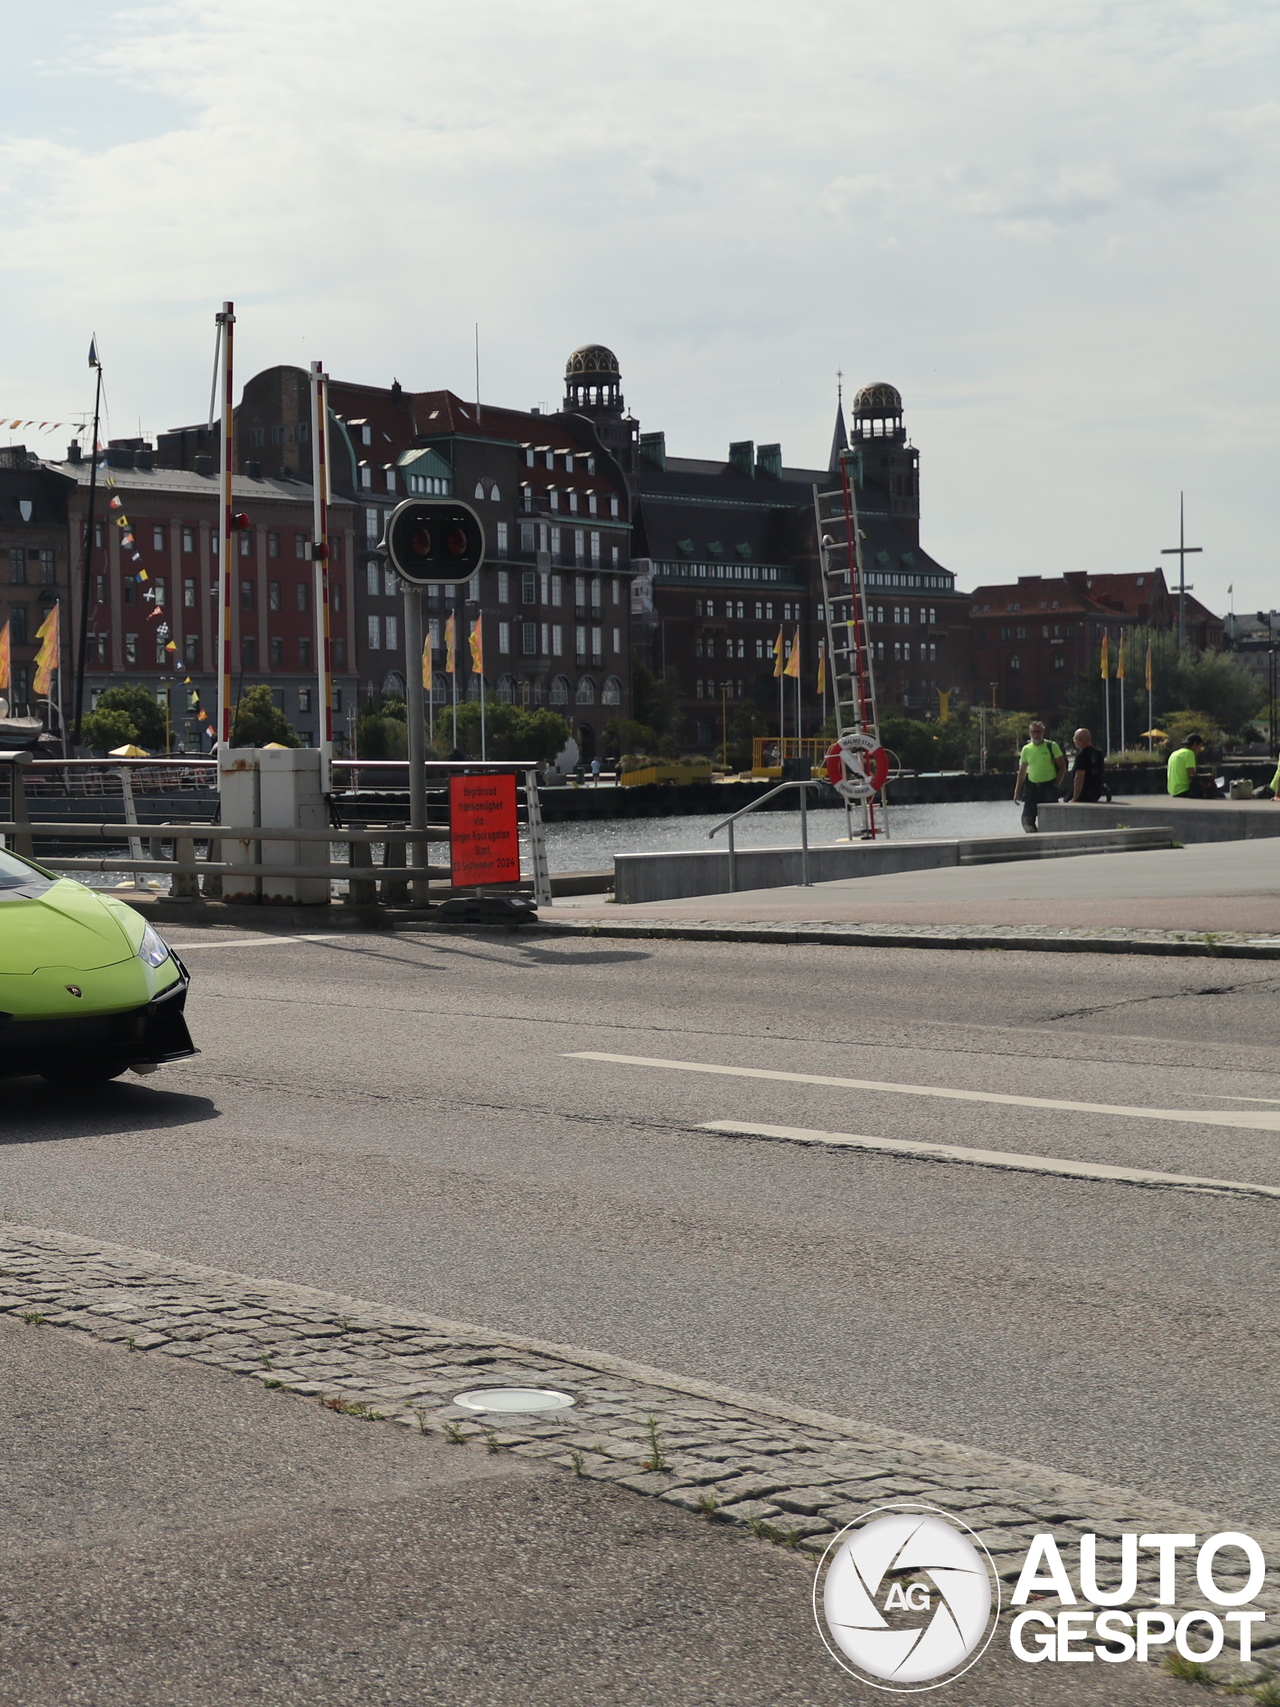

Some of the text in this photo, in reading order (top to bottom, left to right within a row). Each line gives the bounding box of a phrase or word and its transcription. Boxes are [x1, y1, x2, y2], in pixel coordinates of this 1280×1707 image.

[862, 739, 874, 749] STAD
[463, 786, 497, 798] Begränsad
[474, 816, 484, 825] via
[472, 829, 510, 842] Kocksgatan
[475, 845, 490, 855] Start
[453, 857, 515, 872] 23 September 2024
